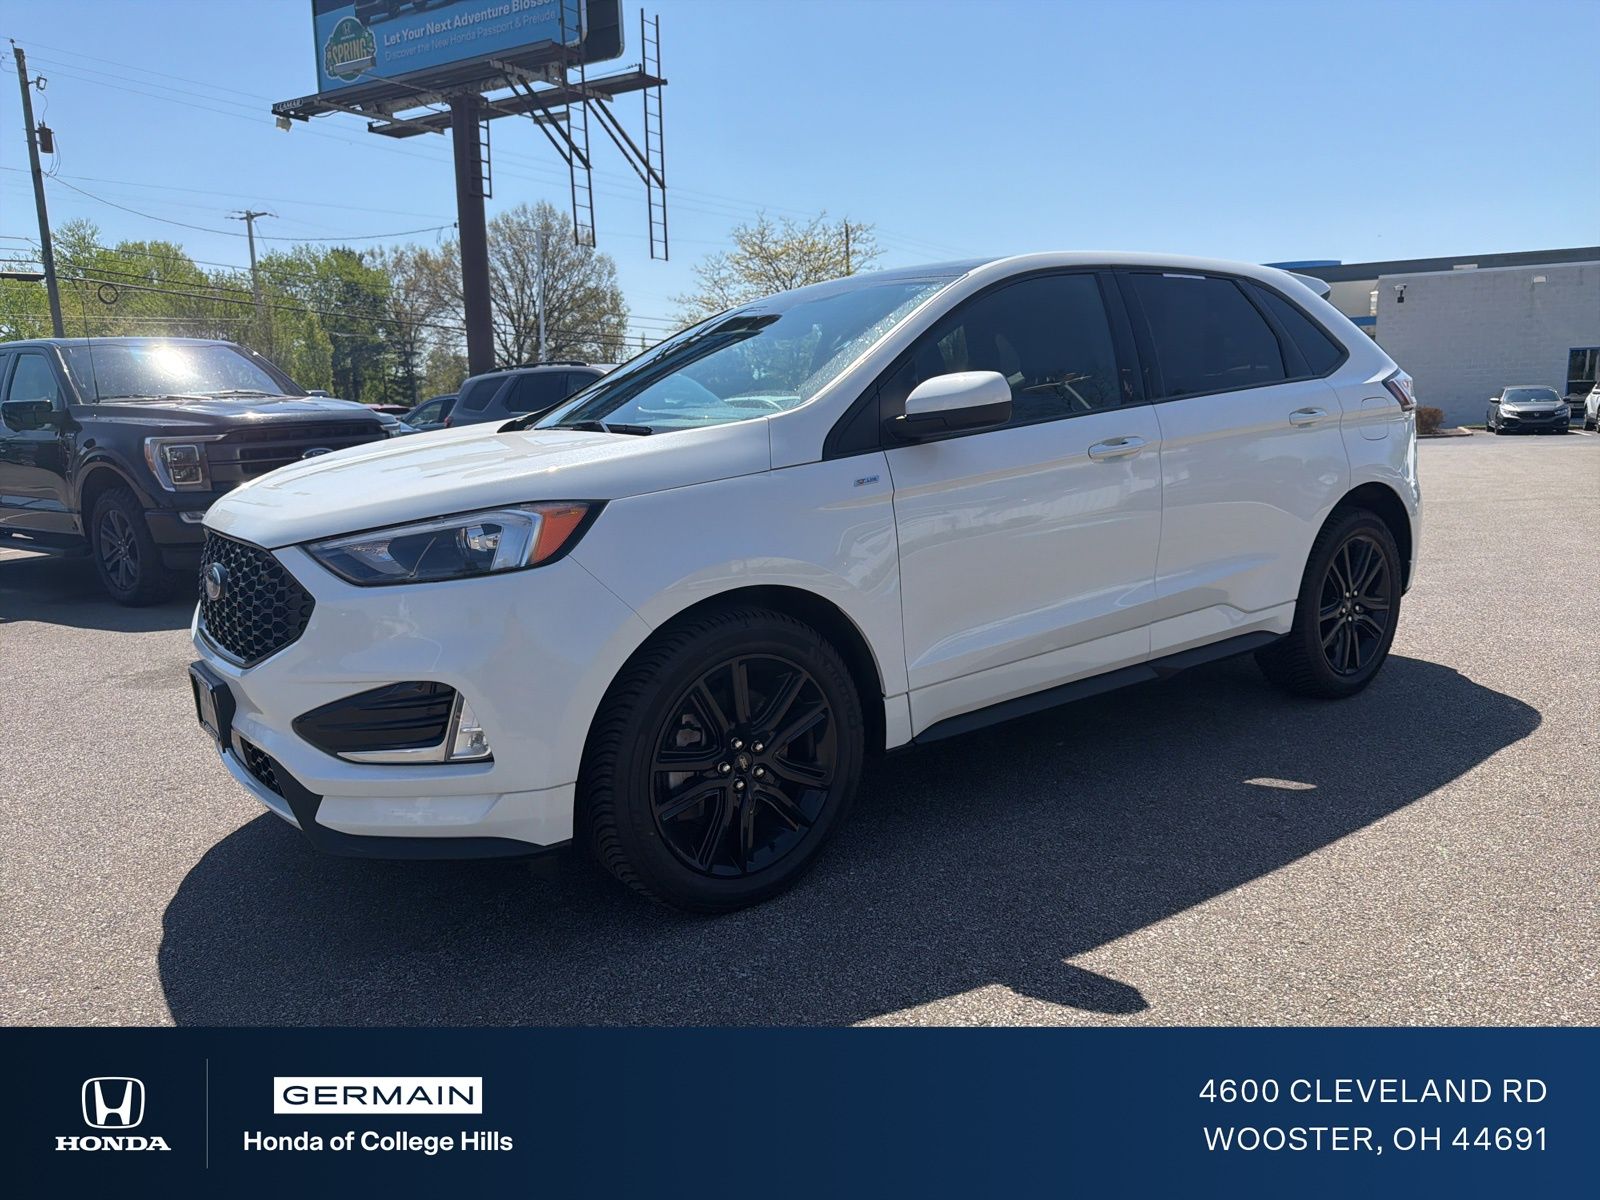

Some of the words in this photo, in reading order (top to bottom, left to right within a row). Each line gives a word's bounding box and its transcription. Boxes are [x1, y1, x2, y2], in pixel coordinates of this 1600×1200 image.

[384, 33, 401, 46] Let
[402, 27, 425, 41] Your
[425, 18, 452, 35] Next
[453, 4, 510, 27] Adventure
[512, 0, 554, 12] Bloss
[384, 47, 416, 61] Discover
[417, 43, 430, 53] the
[431, 37, 450, 49] New
[450, 31, 476, 44] Honda
[476, 19, 514, 39] Passport
[522, 10, 557, 27] Prelude
[332, 38, 367, 63] SPRING
